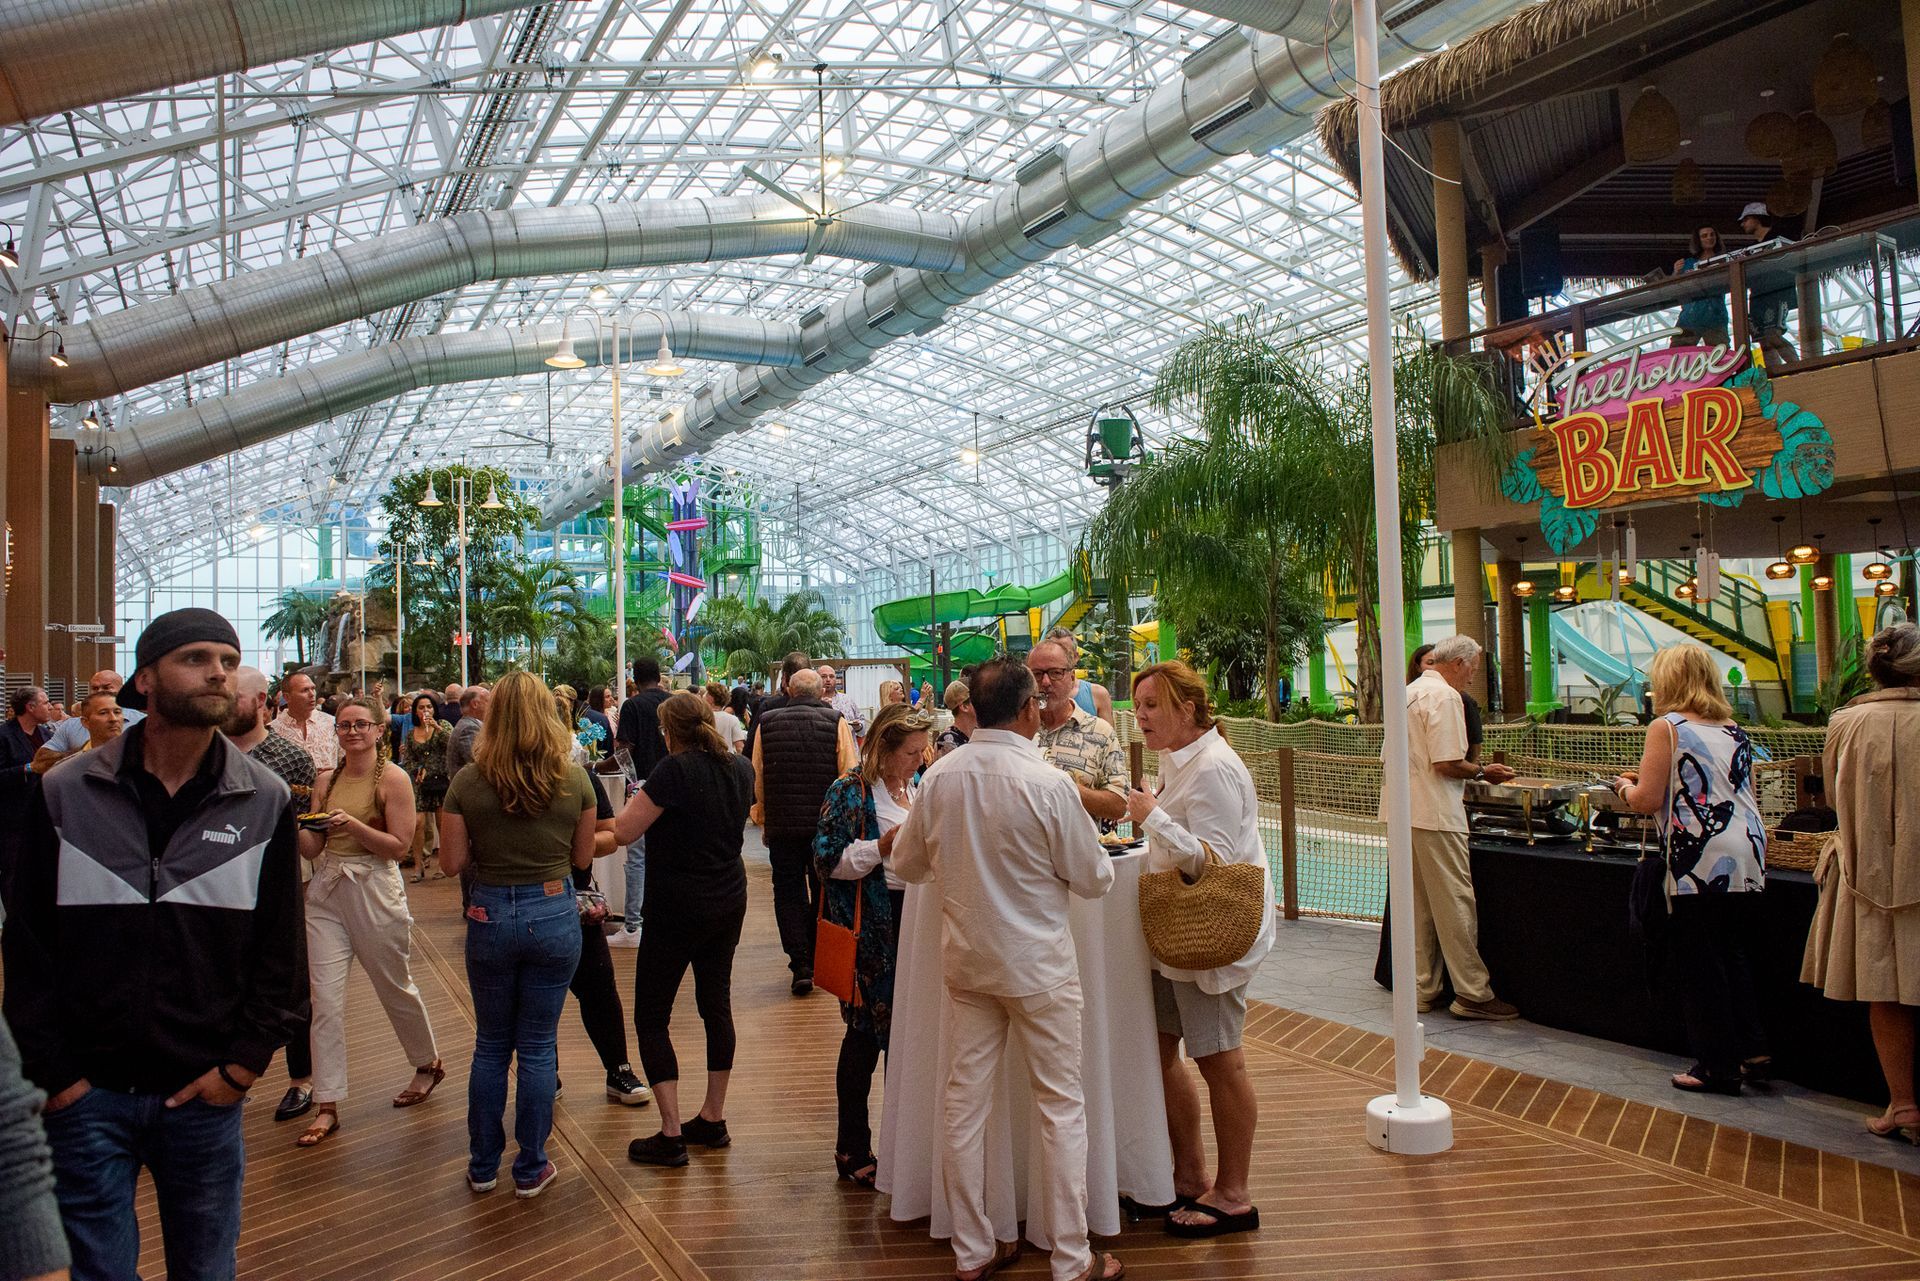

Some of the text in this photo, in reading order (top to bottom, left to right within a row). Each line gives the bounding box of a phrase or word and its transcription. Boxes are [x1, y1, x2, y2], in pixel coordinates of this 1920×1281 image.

[1526, 330, 1571, 375] THE
[1551, 327, 1746, 418] Treehouse
[1550, 387, 1753, 509] BAR
[202, 829, 236, 845] PUMA
